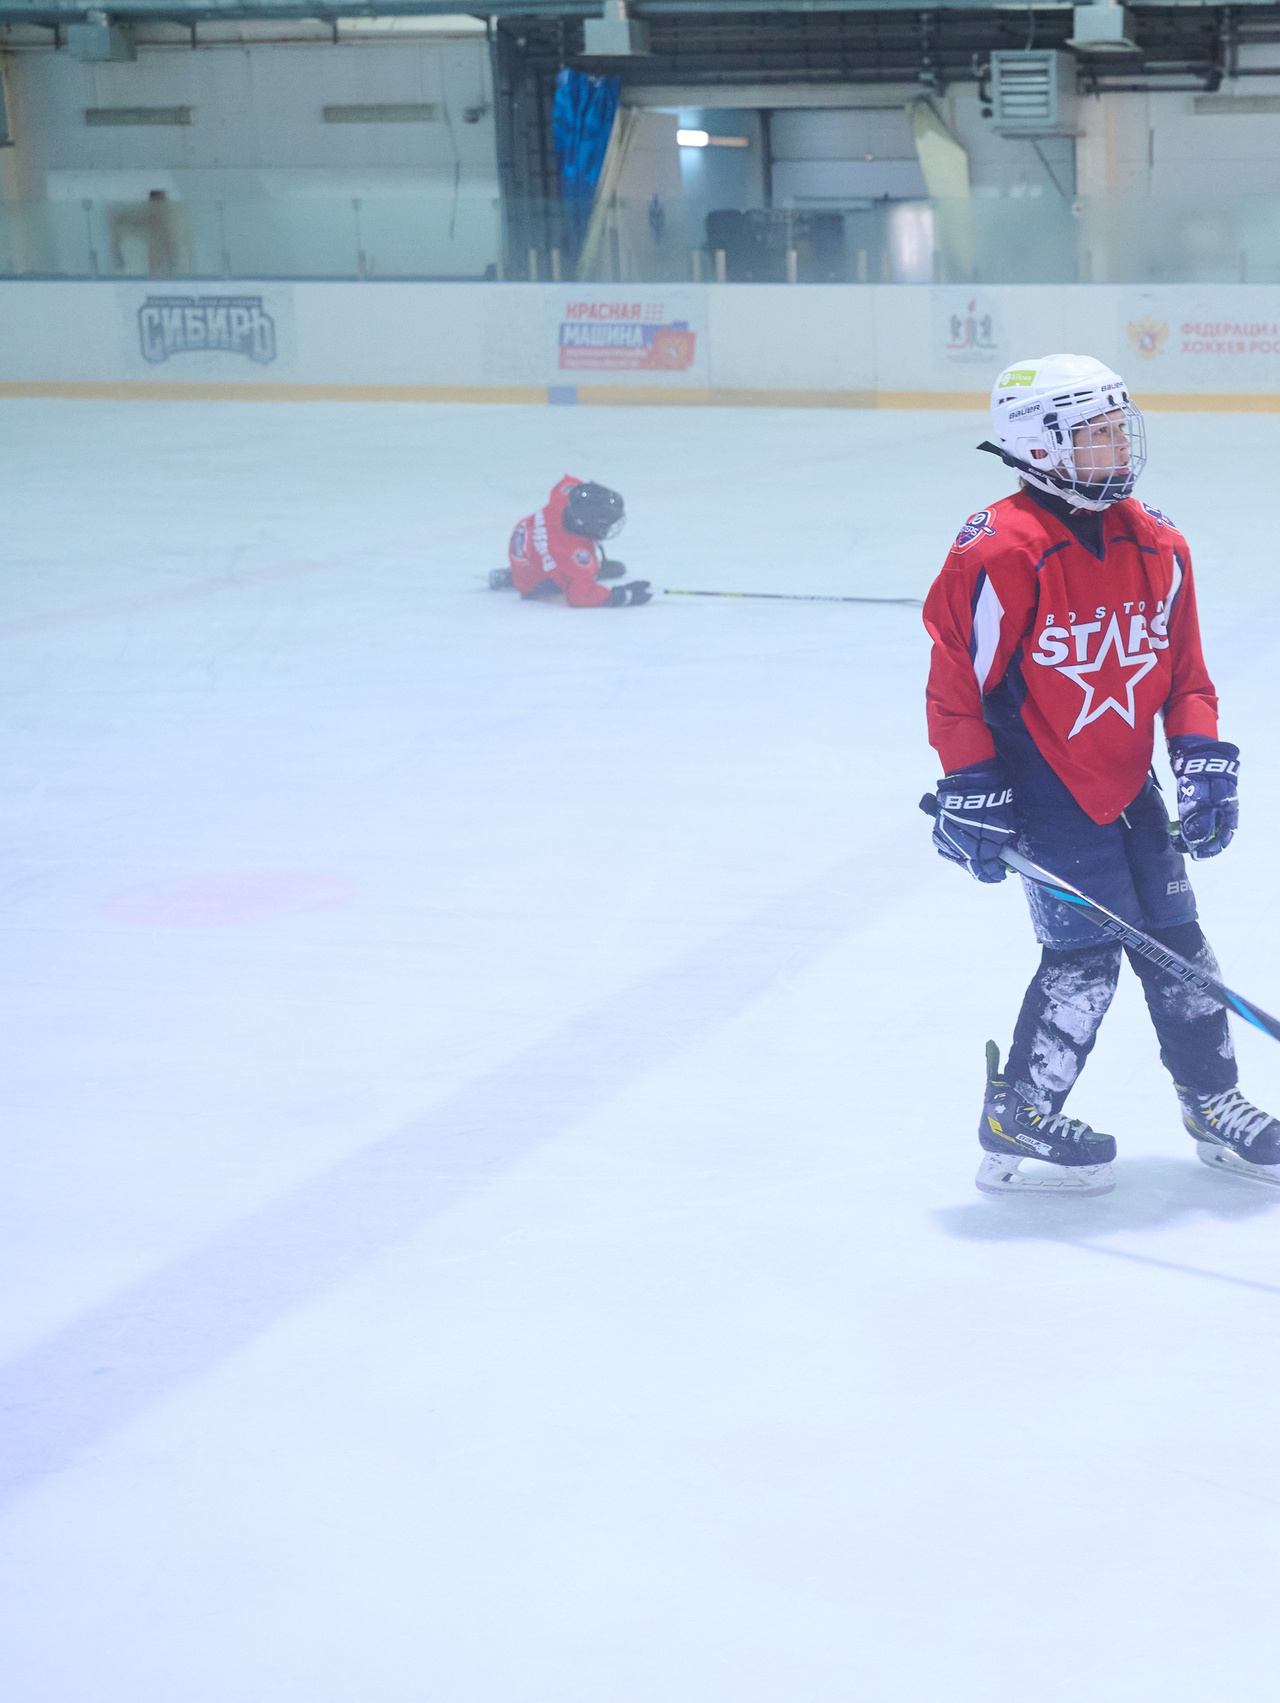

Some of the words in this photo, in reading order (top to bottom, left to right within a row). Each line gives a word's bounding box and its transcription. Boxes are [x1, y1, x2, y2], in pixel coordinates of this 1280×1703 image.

[565, 302, 642, 319] КРАСНАЯ
[138, 306, 276, 365] СИБИРЬ
[563, 324, 643, 346] МАШИНА
[1181, 341, 1245, 354] ХОККЕЯ
[1008, 404, 1040, 420] BAUER
[1045, 600, 1164, 626] BOSTON
[1031, 610, 1170, 667] STARS
[1184, 758, 1238, 777] BAU
[945, 788, 1013, 810] BAUE
